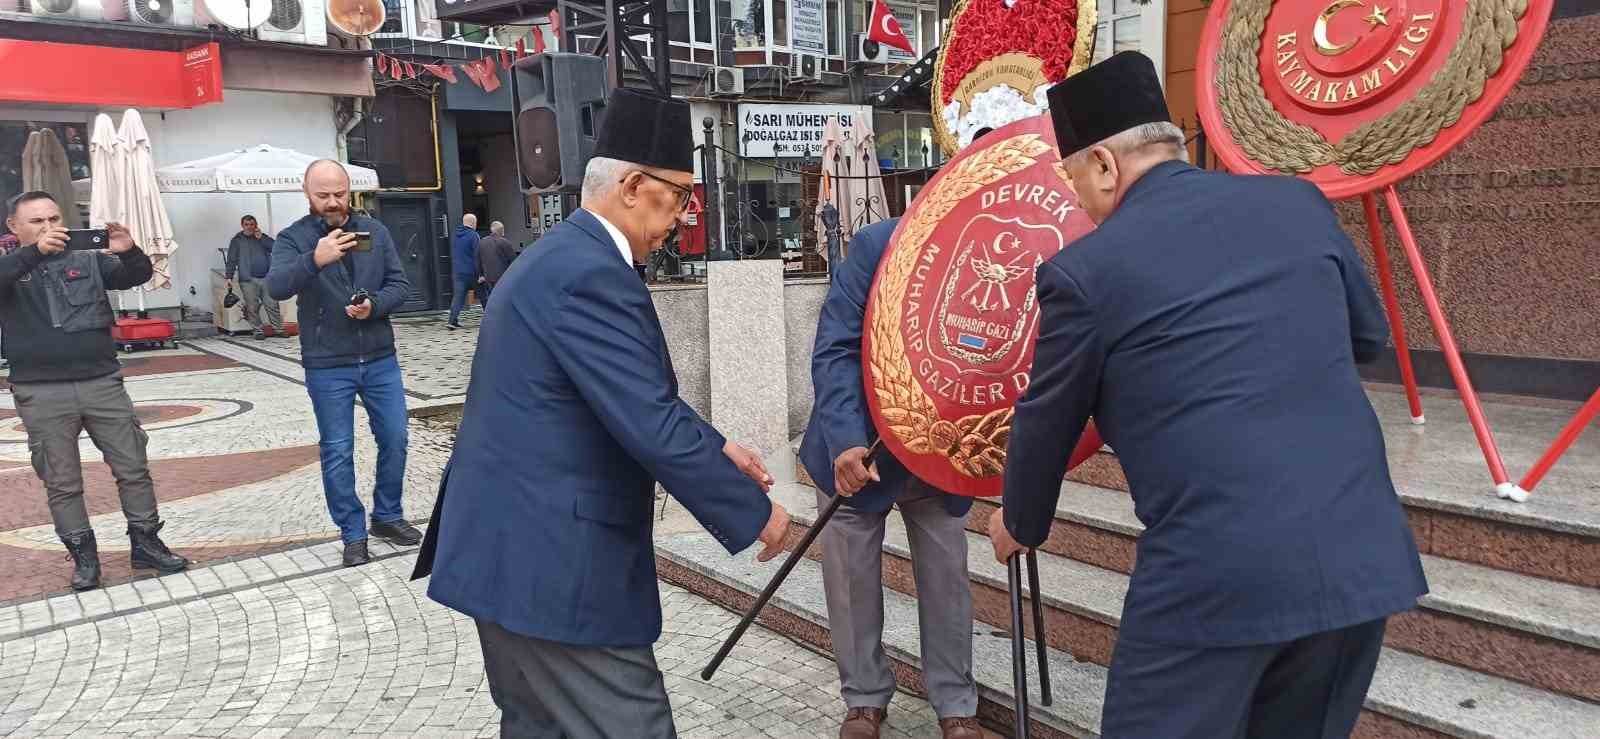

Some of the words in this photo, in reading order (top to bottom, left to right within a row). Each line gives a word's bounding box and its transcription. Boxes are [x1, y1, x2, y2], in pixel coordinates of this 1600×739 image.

[753, 114, 782, 127] SARI
[747, 128, 798, 141] DOĞALGAZ
[246, 176, 301, 185] GELATERIA
[981, 183, 1076, 224] DEVREK
[906, 243, 941, 353] MUHARİP
[945, 313, 986, 334] MUHARİP
[985, 321, 1011, 339] GAZİ
[919, 358, 1006, 405] GAZİLER
